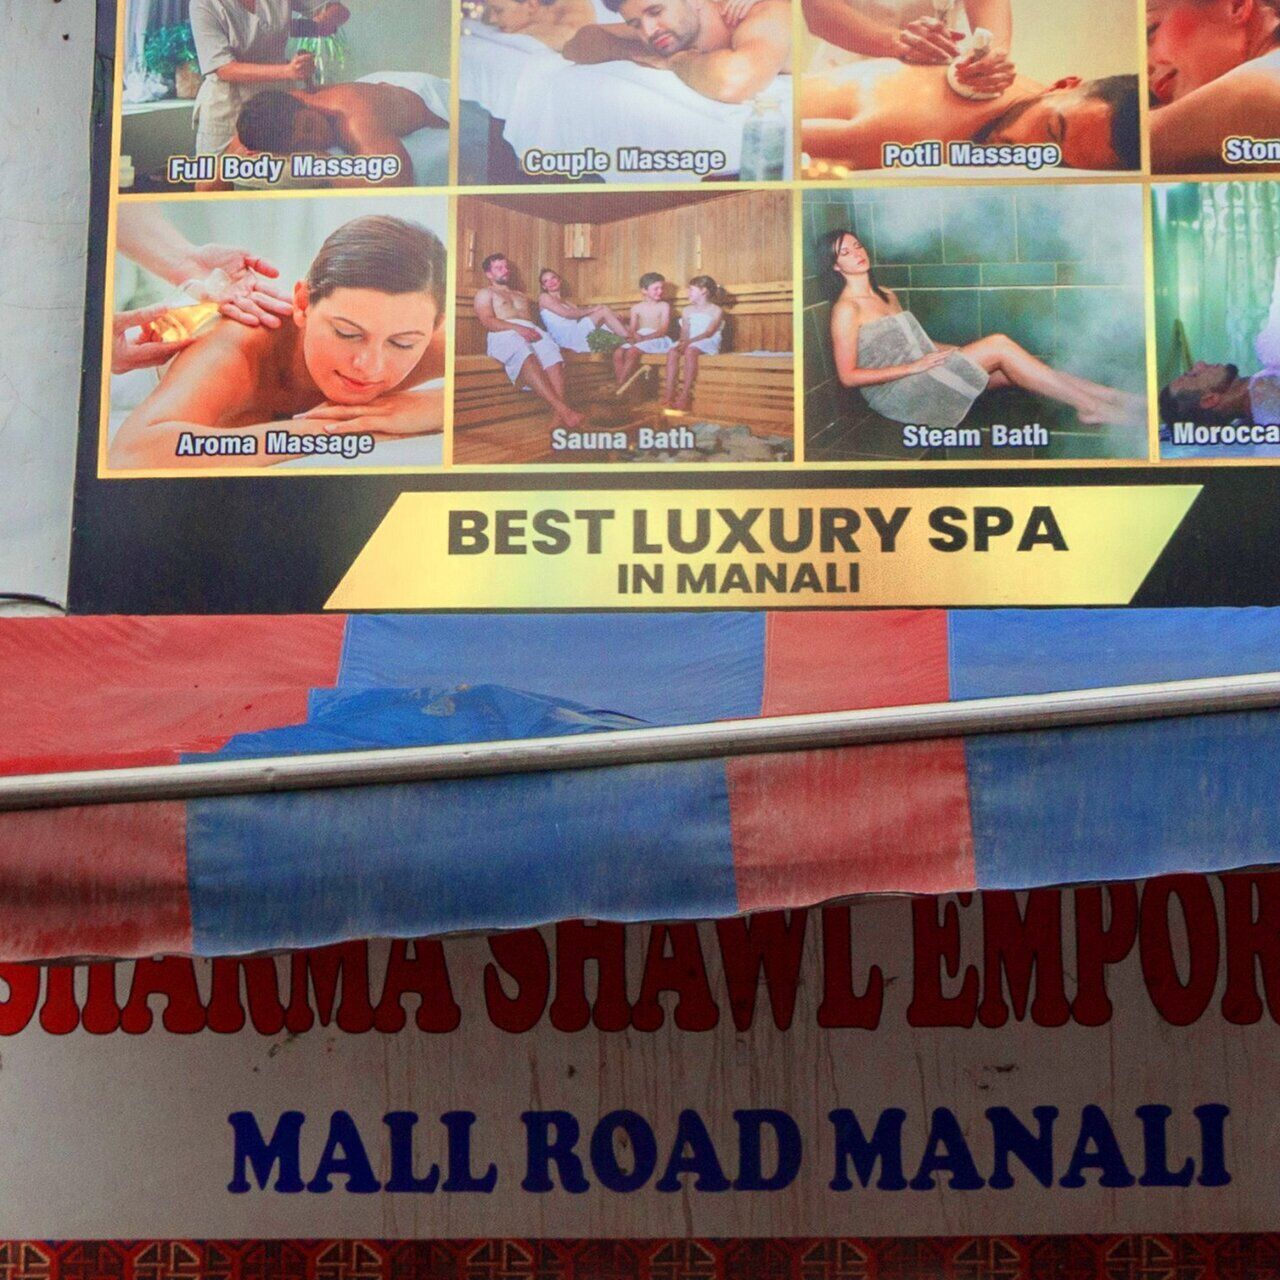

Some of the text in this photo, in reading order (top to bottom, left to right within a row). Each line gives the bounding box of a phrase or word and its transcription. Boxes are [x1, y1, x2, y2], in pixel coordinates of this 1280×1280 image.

[170, 153, 400, 183] Full Body Massage
[524, 147, 725, 177] Couple Massage
[883, 142, 1060, 169] Potli Massage
[176, 430, 375, 459] Aroma Massage
[551, 426, 695, 450] Sauna Bath
[902, 423, 1049, 448] Steam Bath
[447, 504, 1070, 555] BEST LUXURY SPA
[617, 561, 860, 595] IN MANALI
[483, 905, 885, 1034] SHAWL
[227, 1104, 1232, 1194] MALL ROAD MANALI
